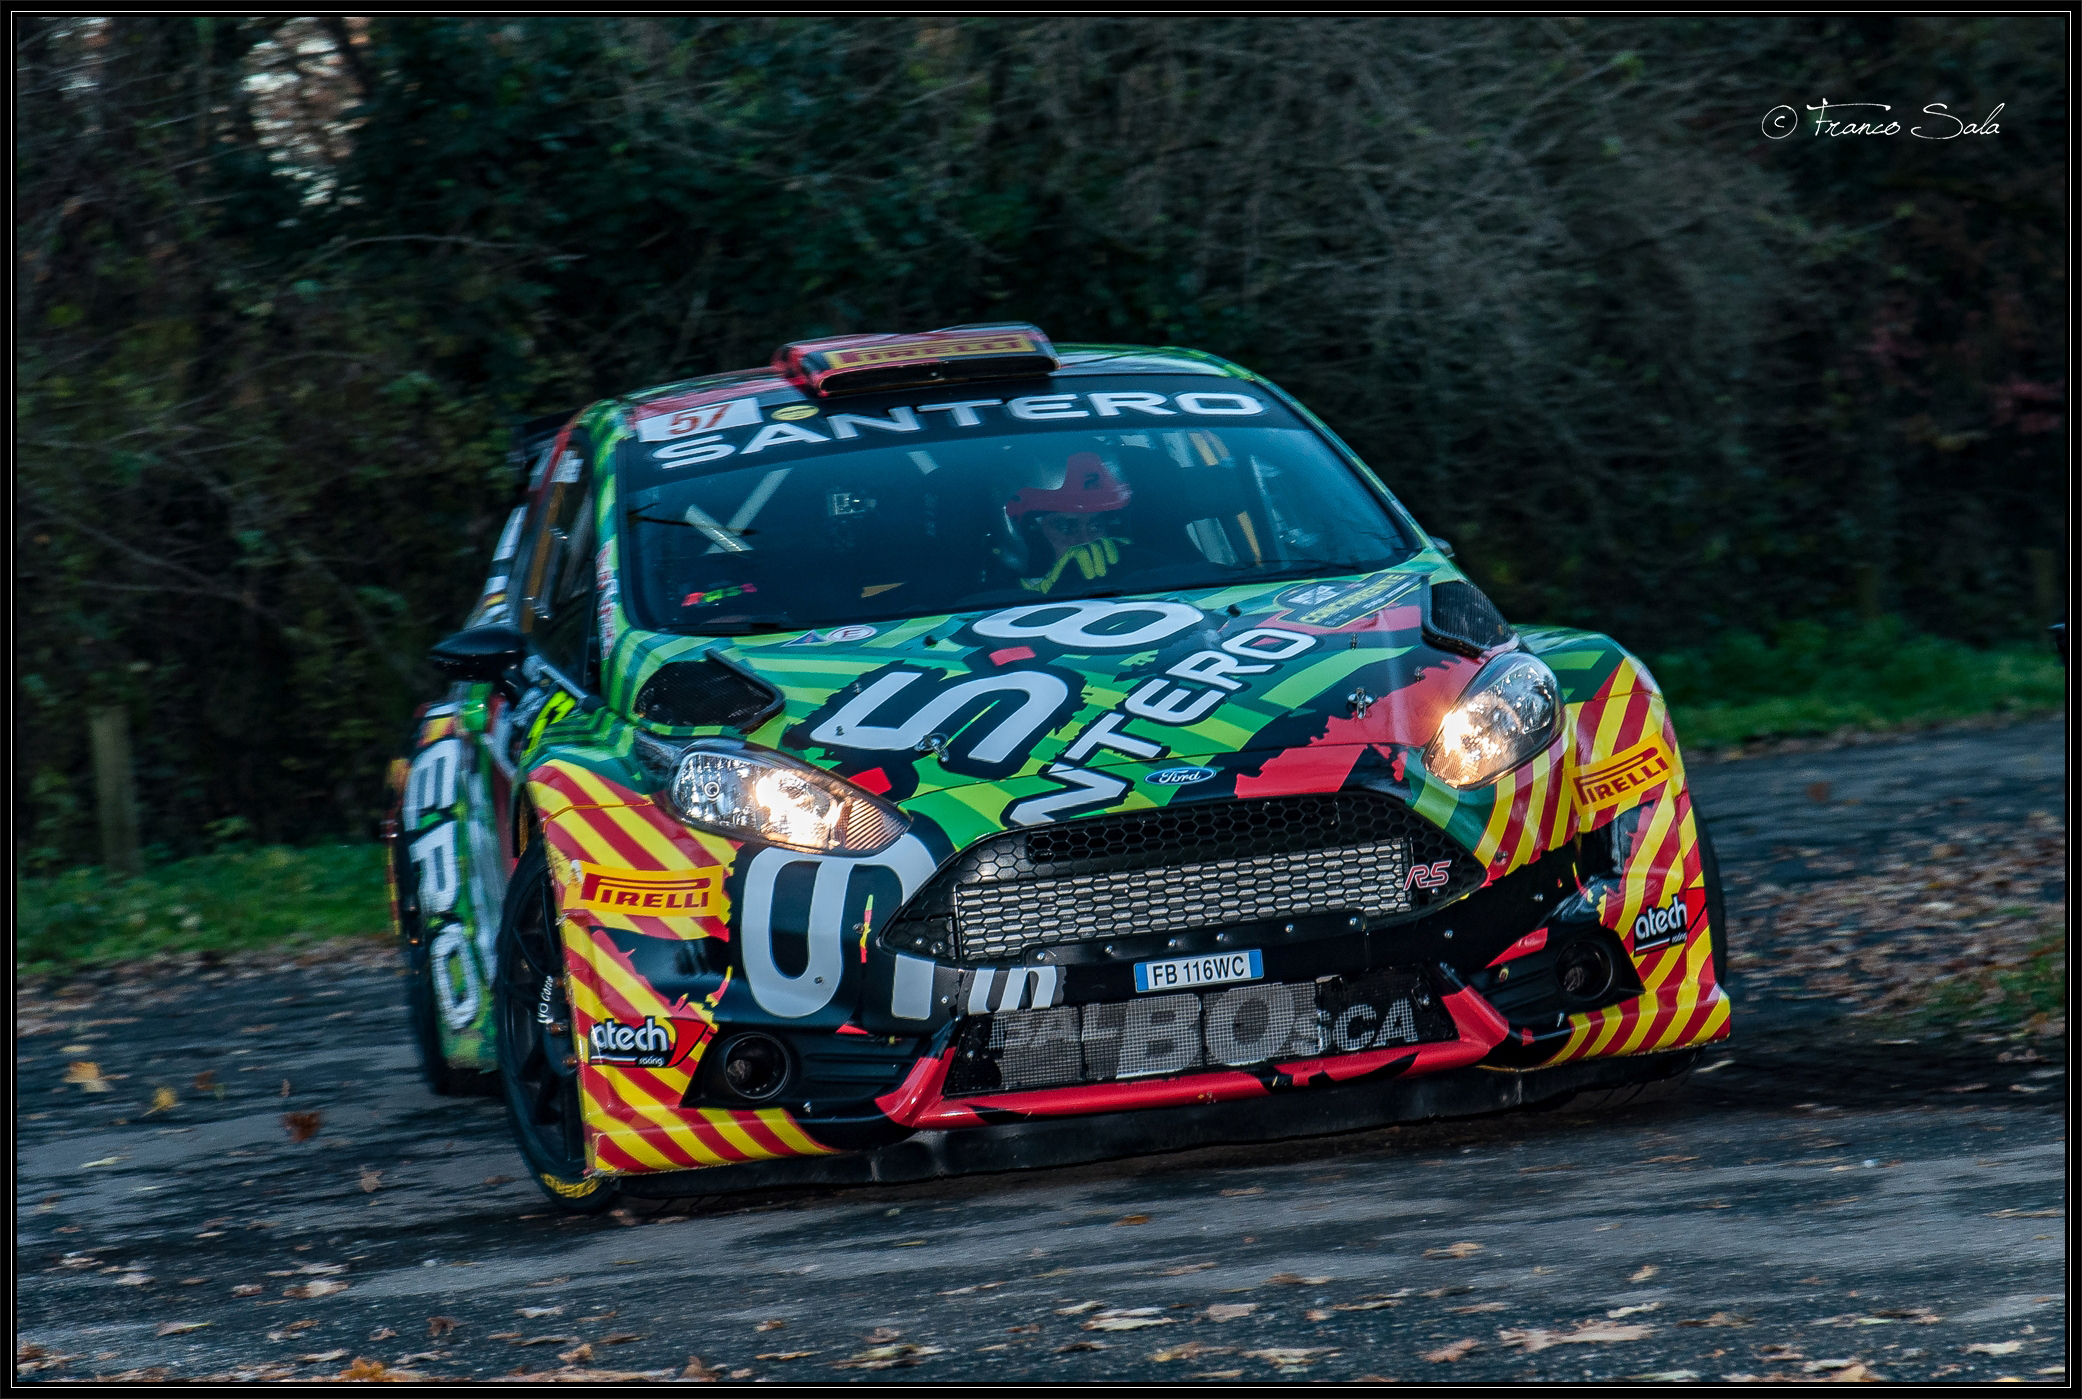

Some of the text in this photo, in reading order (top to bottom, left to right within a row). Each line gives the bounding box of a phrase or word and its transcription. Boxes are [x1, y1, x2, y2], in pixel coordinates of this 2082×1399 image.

[651, 391, 1264, 470] SANTERO
[668, 403, 733, 435] 57
[1158, 769, 1201, 784] Ford
[1572, 746, 1669, 806] PIRELLI
[580, 873, 711, 909] PIRELLI
[1635, 896, 1687, 940] atech
[1152, 956, 1245, 986] FB 116WC
[591, 1018, 669, 1052] atech
